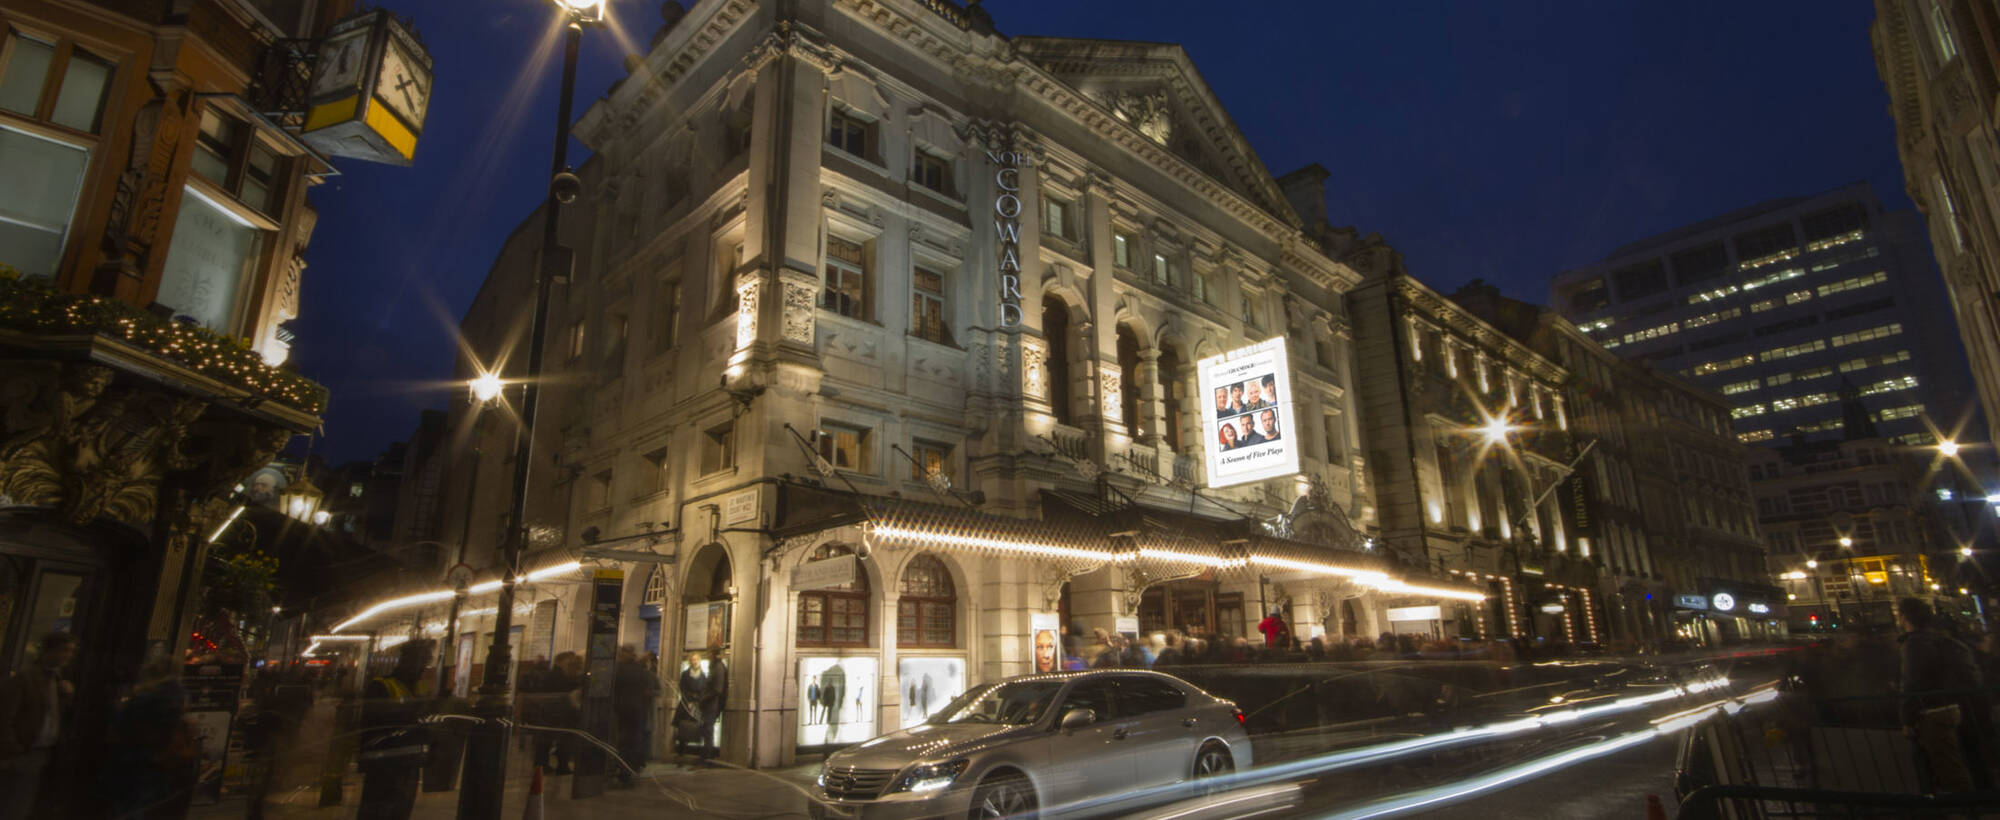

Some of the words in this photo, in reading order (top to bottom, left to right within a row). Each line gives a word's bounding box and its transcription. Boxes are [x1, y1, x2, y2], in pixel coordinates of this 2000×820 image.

[995, 168, 1023, 328] COWARD
[1220, 457, 1226, 465] A
[1226, 455, 1246, 464] Season
[1246, 451, 1252, 460] of
[1253, 450, 1266, 459] Five
[1267, 447, 1284, 456] Plays
